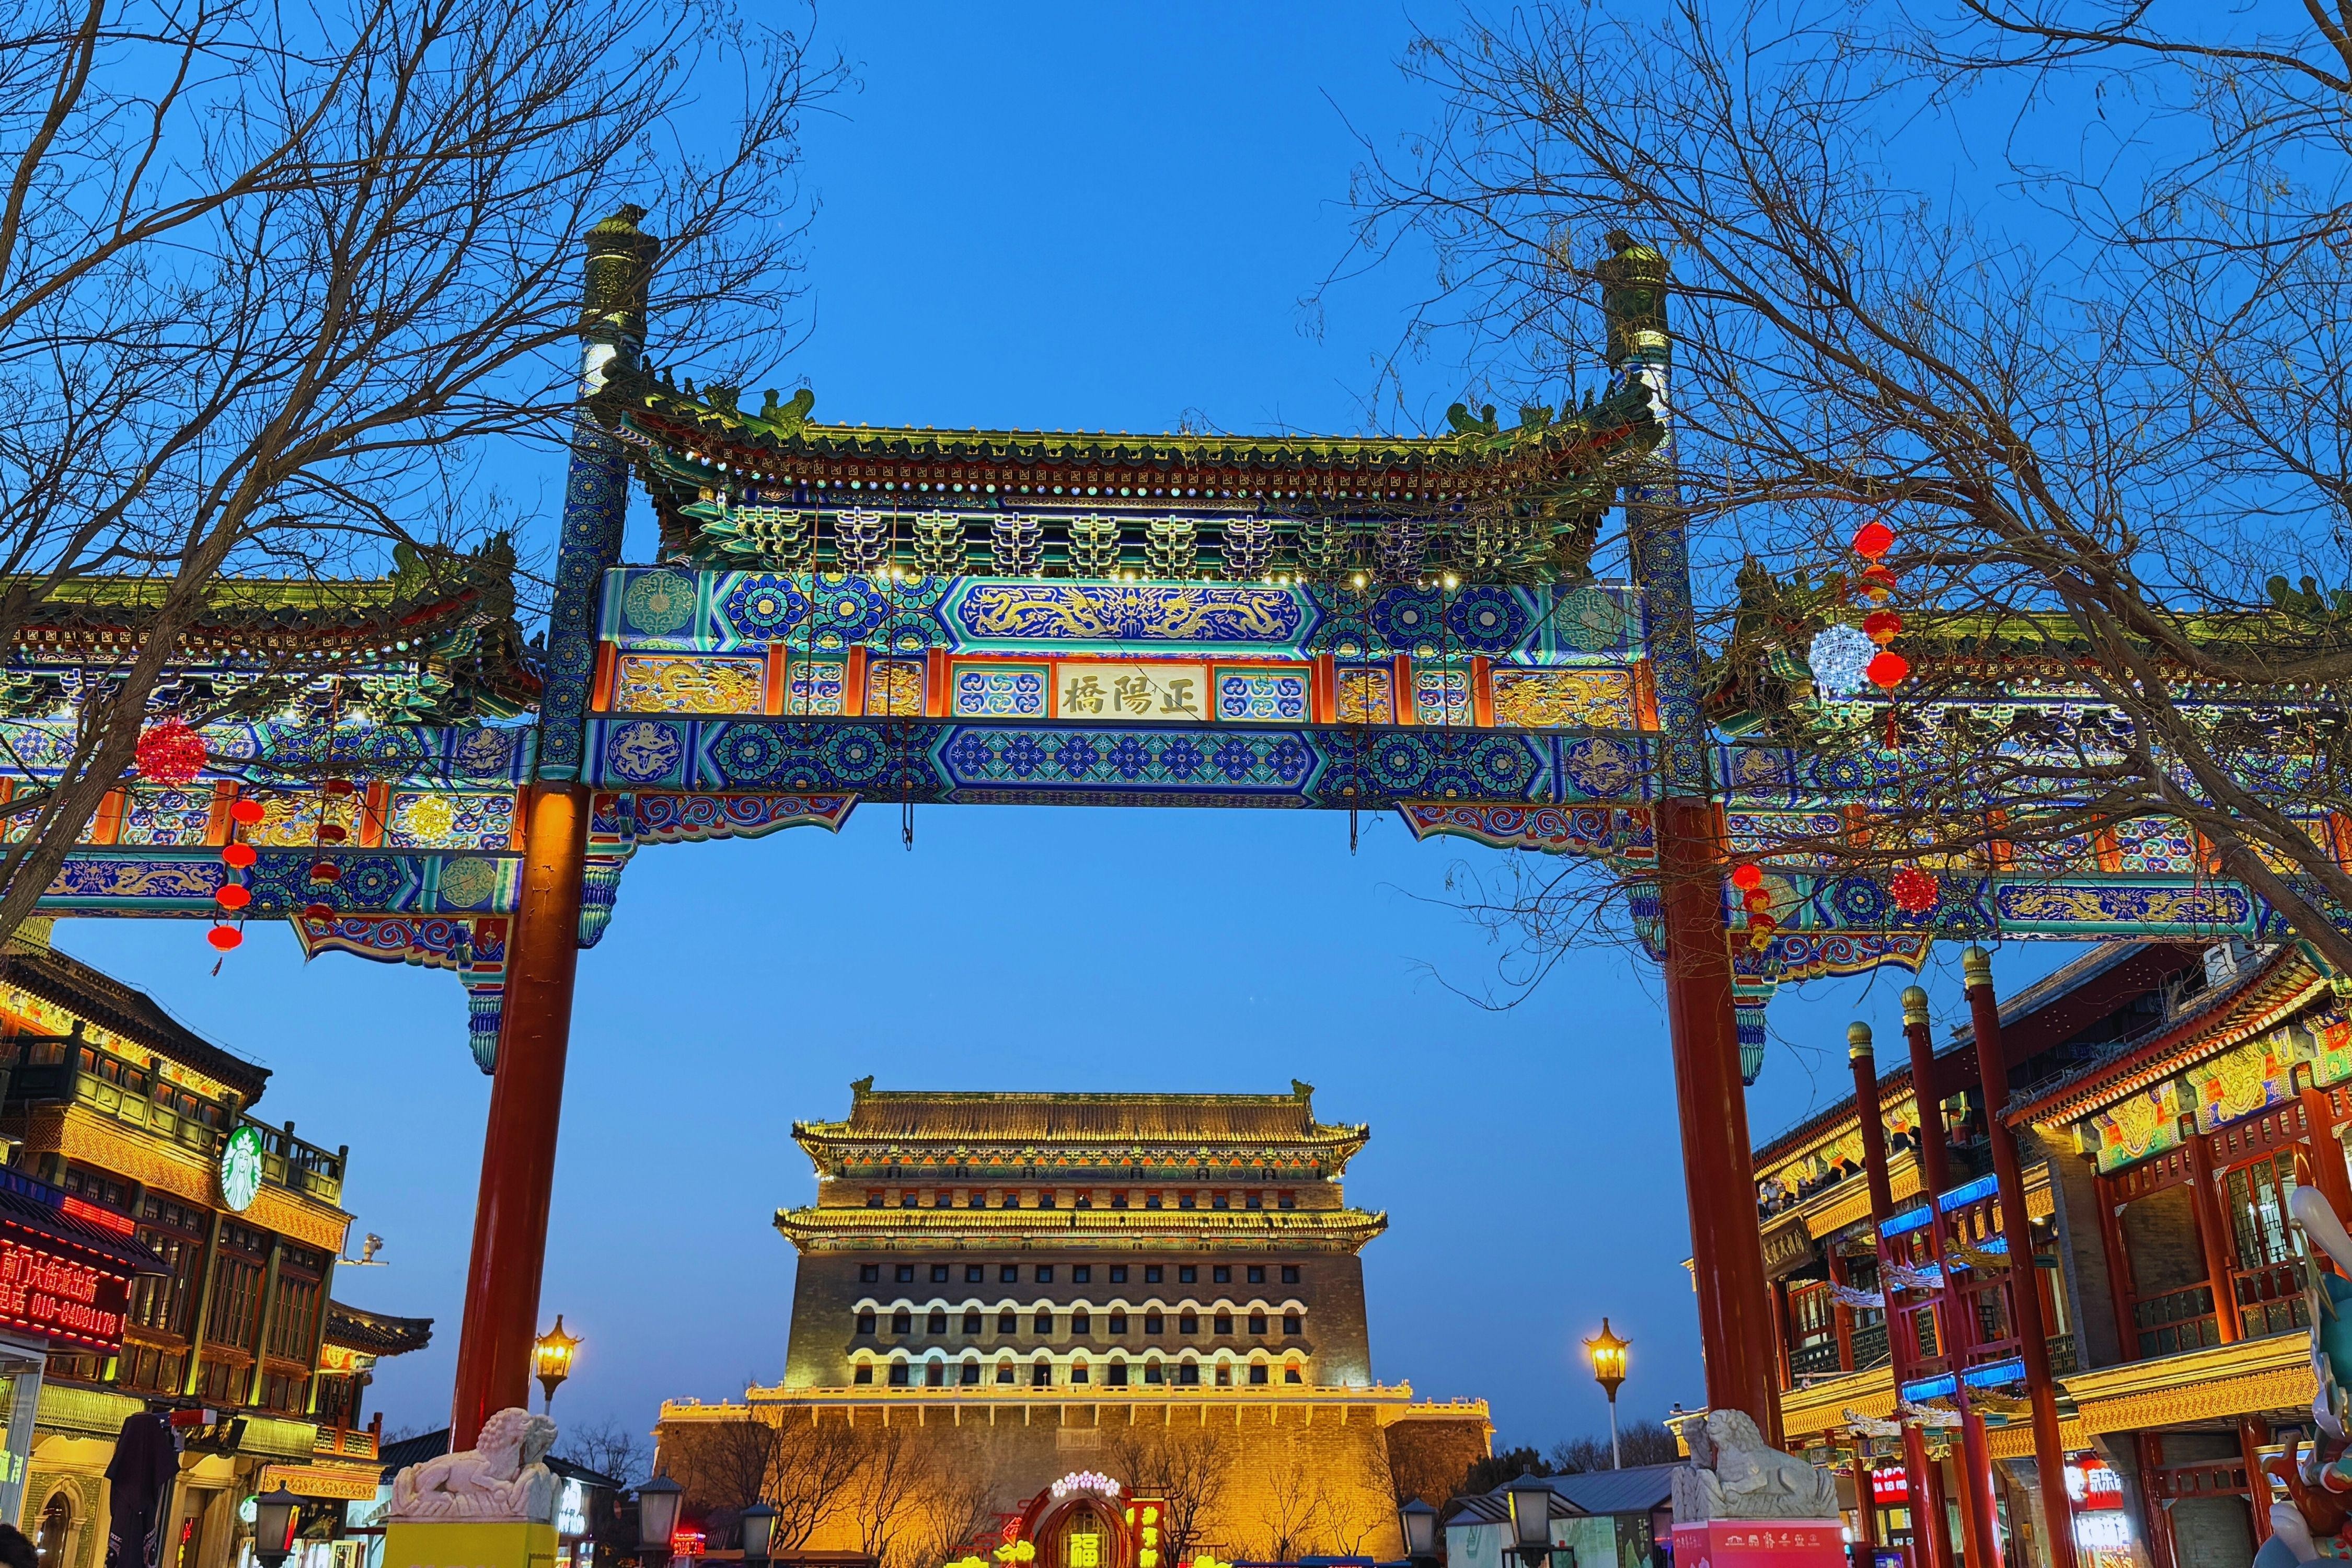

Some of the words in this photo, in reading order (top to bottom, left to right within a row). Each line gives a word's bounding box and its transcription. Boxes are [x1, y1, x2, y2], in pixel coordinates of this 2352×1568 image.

[1063, 676, 1198, 715] 正陽橋
[2, 1248, 99, 1302] 前门大街派出所
[1071, 1534, 1098, 1567] 福
